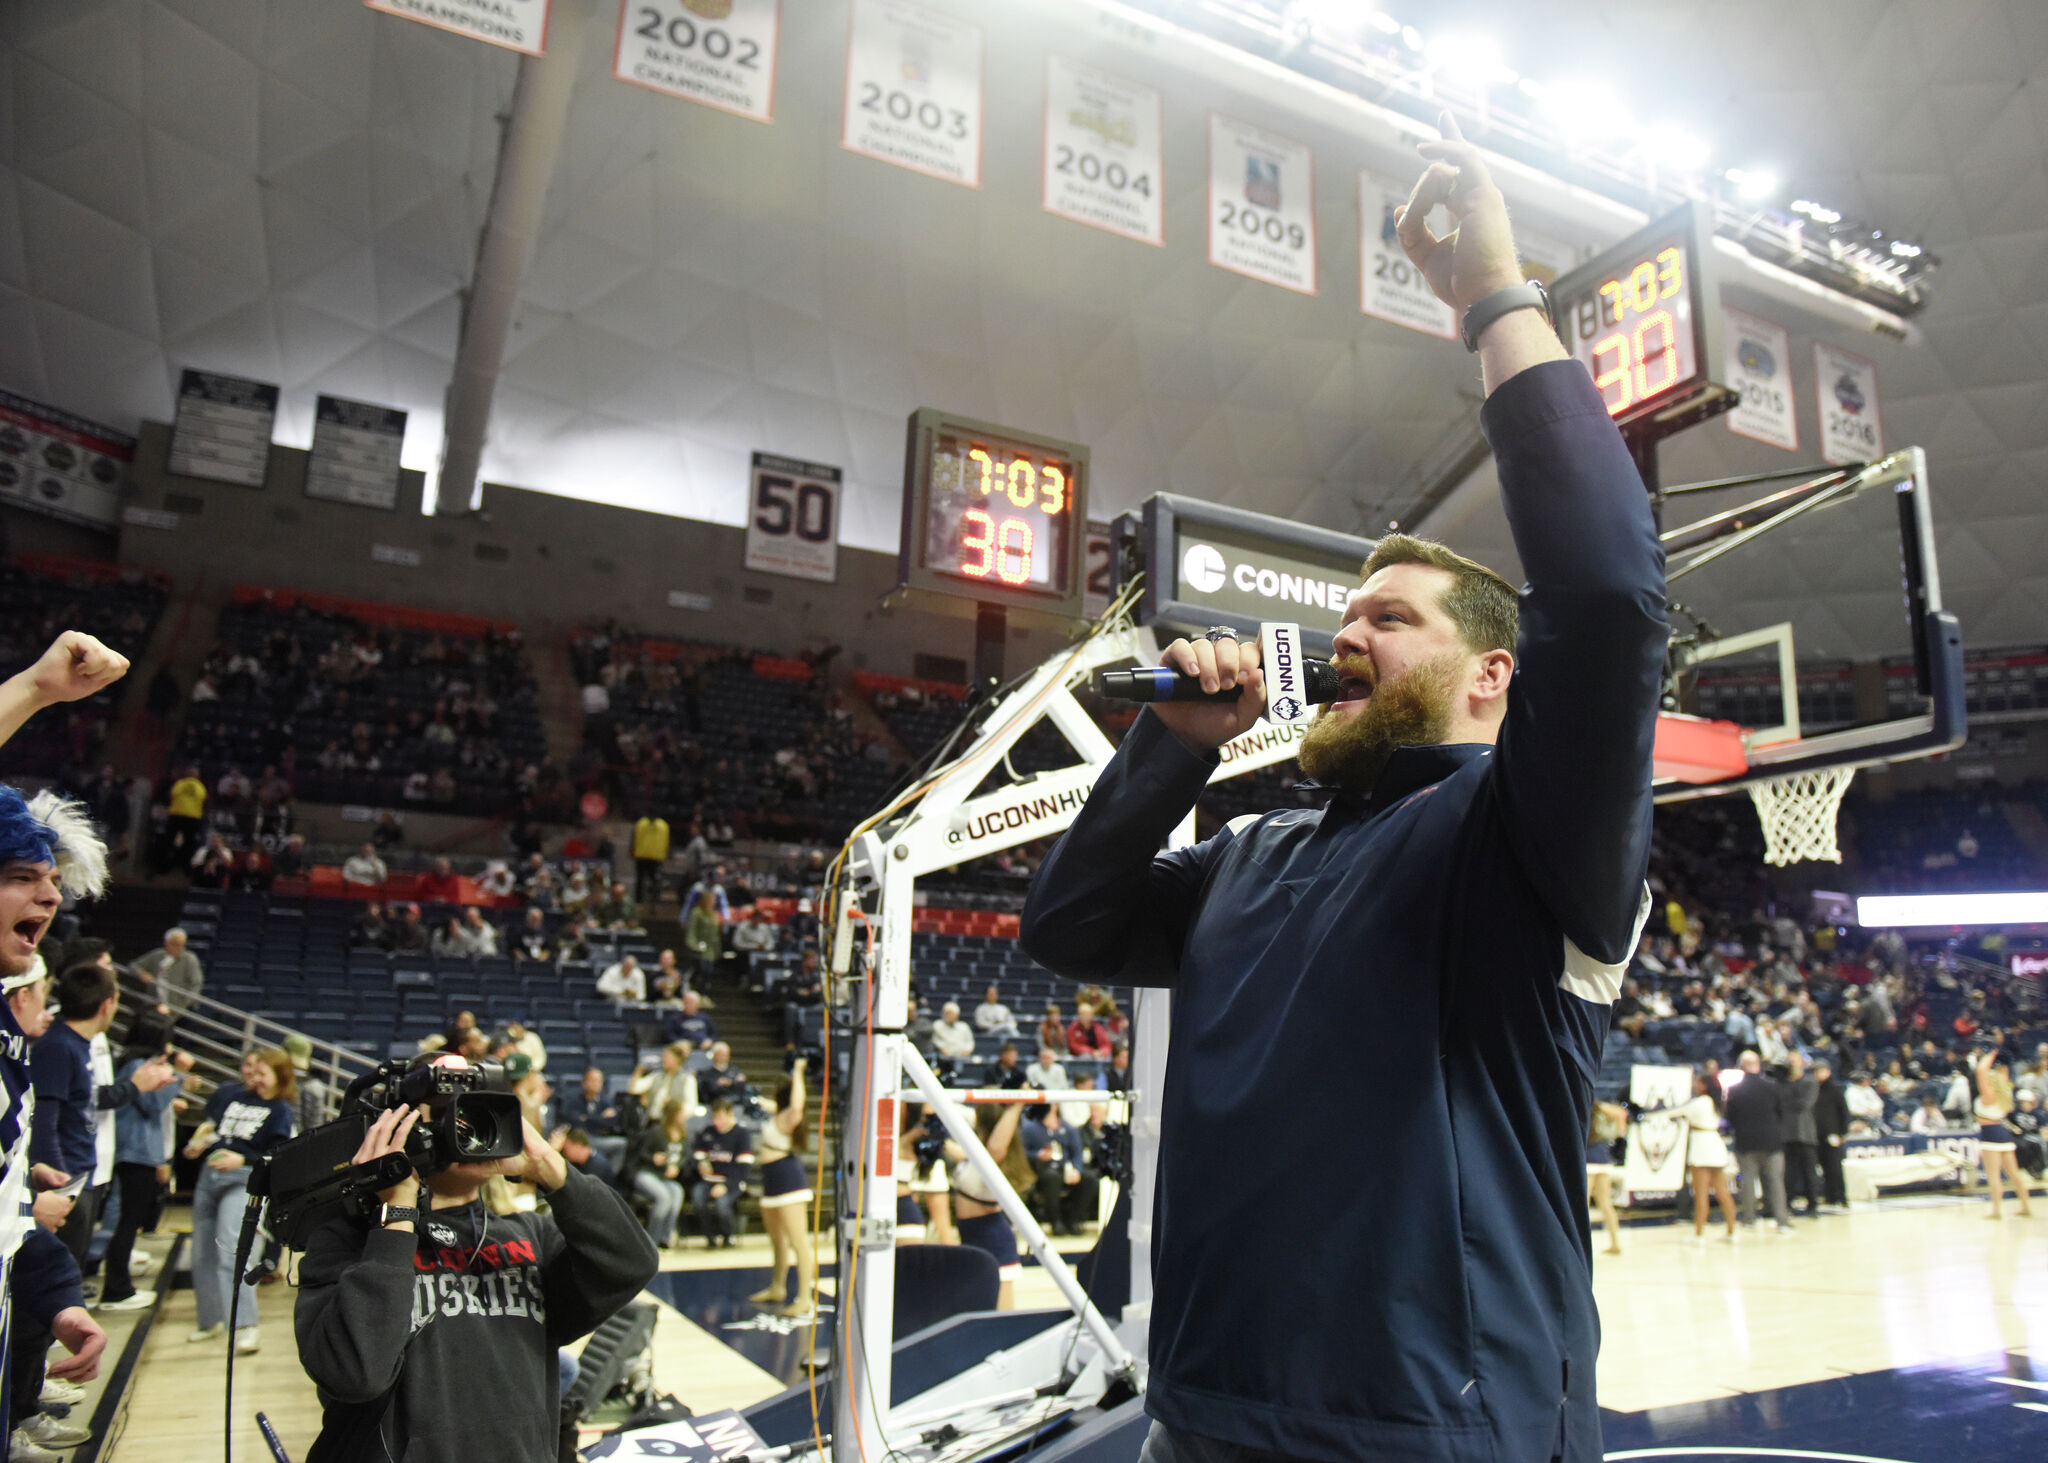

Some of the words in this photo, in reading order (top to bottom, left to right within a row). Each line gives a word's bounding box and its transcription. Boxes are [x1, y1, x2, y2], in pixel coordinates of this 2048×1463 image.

[635, 6, 760, 70] 2002
[859, 81, 968, 141] 2003
[1055, 144, 1153, 200] 2004
[1219, 200, 1305, 251] 2009
[1373, 252, 1434, 298] 201
[1600, 247, 1682, 321] 7:03
[1592, 309, 1679, 416] 30
[1829, 410, 1877, 447] 2016
[756, 474, 833, 543] 50
[969, 449, 1065, 515] 7:03
[961, 509, 1033, 585] 30
[1275, 628, 1294, 692] UCONN
[410, 1265, 546, 1333] USKIES
